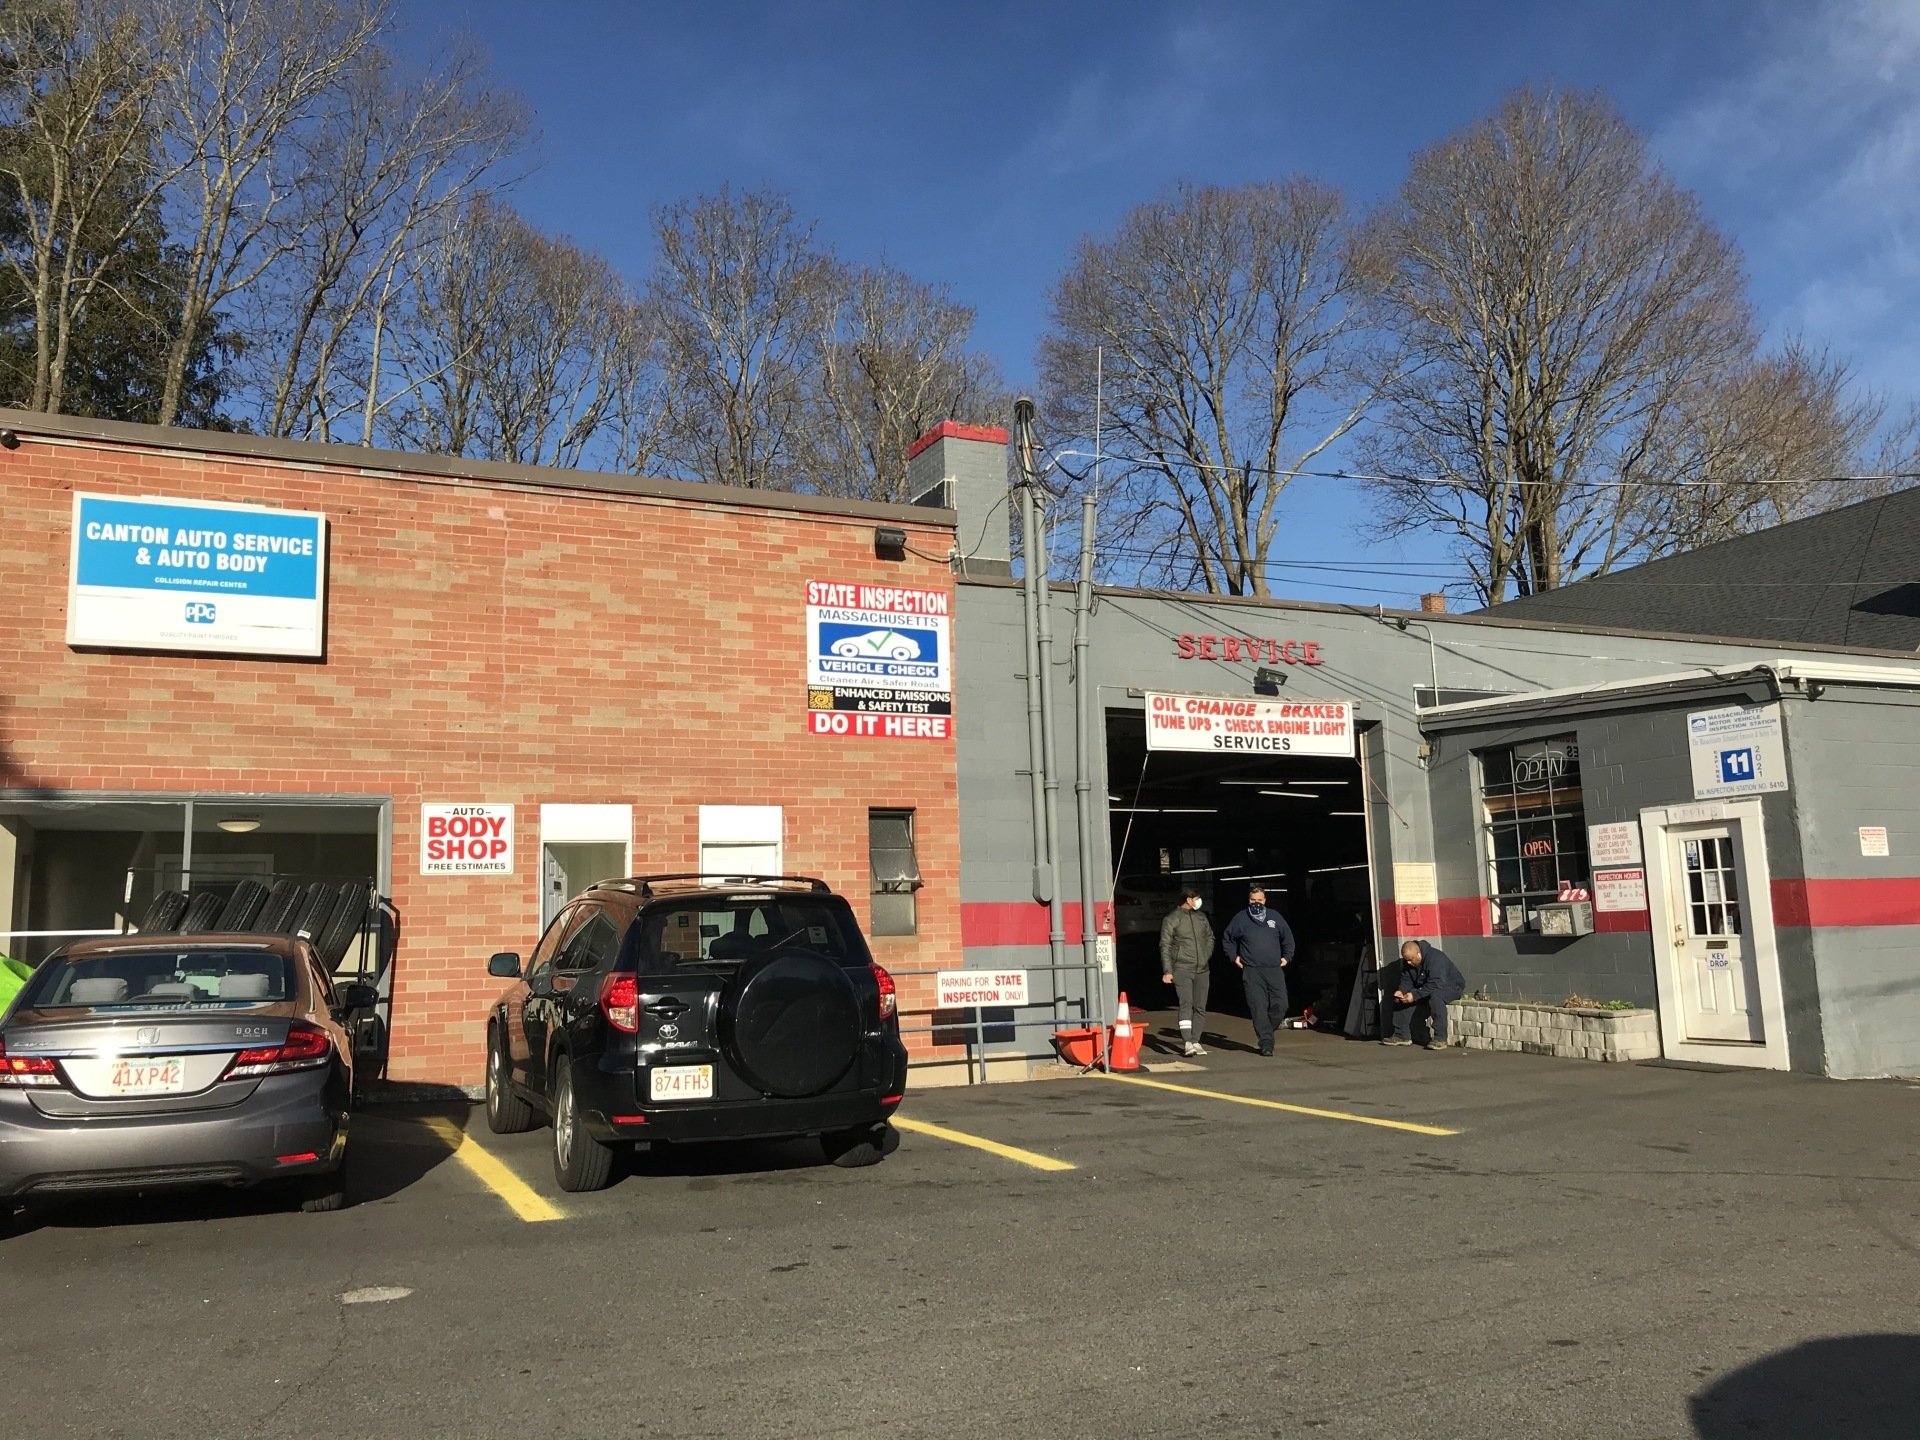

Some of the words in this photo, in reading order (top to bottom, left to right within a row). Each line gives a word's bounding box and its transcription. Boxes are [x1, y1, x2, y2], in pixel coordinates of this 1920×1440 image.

[87, 522, 168, 544] CANTON
[175, 529, 226, 549] AUTO
[233, 533, 312, 555] SERVICE
[136, 548, 150, 565] &
[157, 550, 209, 569] AUTO
[216, 553, 268, 573] BODY
[155, 577, 192, 585] COLLISION
[194, 579, 218, 587] REPAIR
[809, 581, 856, 606] STATE
[860, 586, 947, 614] INSPECTION
[186, 603, 215, 622] PPG
[819, 609, 938, 627] MASSACHUSETTS
[1177, 634, 1321, 665] SERVICE
[822, 661, 884, 674] VEHICLE
[888, 665, 936, 677] CHECK
[820, 675, 857, 684] Cleaner
[861, 677, 874, 685] Air
[883, 679, 907, 687] Safer
[835, 688, 892, 700] ENHANCED
[895, 691, 950, 702] EMISSIONS
[858, 701, 866, 710] &
[868, 701, 903, 712] SAFETY
[906, 703, 929, 712] TEST
[1152, 697, 1180, 712] OIL
[1185, 700, 1256, 716] CHANGE
[1280, 704, 1344, 719] BRAKES
[1708, 708, 1763, 720] MASSACHUSETTS
[815, 713, 848, 733] DO
[856, 716, 878, 734] IT
[886, 717, 946, 737] HERE
[1153, 714, 1185, 730] TUNE
[1189, 716, 1211, 731] UPS
[1225, 719, 1265, 734] CHECK
[1268, 720, 1309, 735] ENGINE
[1313, 722, 1346, 736] LIGHT
[1710, 723, 1746, 732] INSPECTION
[1734, 715, 1760, 723] VEHICLE
[1213, 735, 1290, 750] SERVICES
[1515, 757, 1562, 782] OPEN
[1727, 752, 1749, 774] 11
[1706, 785, 1734, 794] INSPECTION
[1736, 783, 1757, 791] STATION
[428, 817, 506, 837] BODY
[428, 840, 507, 859] SHOP
[1524, 841, 1552, 856] OPEN
[942, 977, 972, 987] PARKING
[975, 977, 989, 985] FOR
[995, 975, 1022, 986] STATE
[943, 990, 999, 1003] INSPECTION
[1004, 992, 1024, 1001] ONLY!
[236, 1027, 268, 1035] BOCH
[112, 1069, 144, 1086] 41X
[149, 1066, 179, 1085] P42
[656, 1076, 679, 1092] 874
[685, 1074, 709, 1089] FH3
